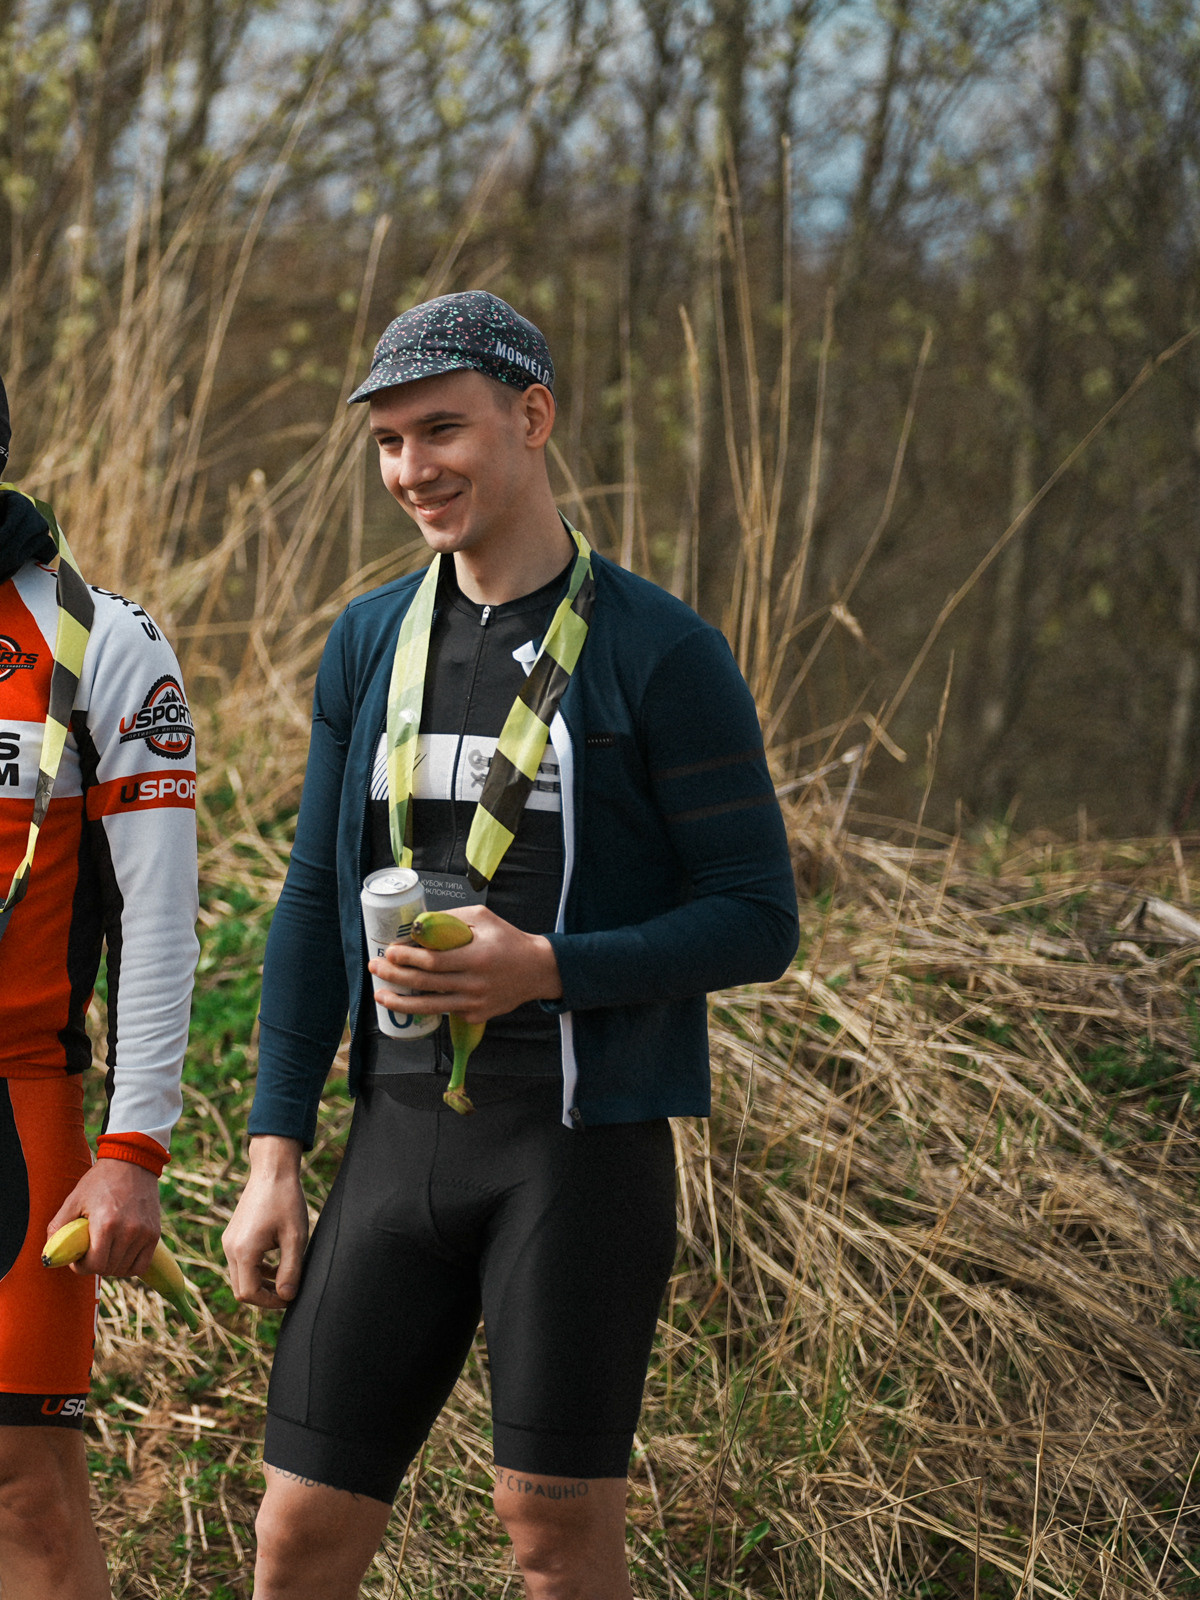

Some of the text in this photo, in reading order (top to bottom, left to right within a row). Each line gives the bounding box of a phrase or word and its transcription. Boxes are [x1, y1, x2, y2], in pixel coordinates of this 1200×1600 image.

[495, 341, 550, 385] MORVÉLO
[424, 888, 467, 900] ИКЛОКРОСС
[445, 881, 464, 890] ТИПА
[507, 1475, 589, 1500] СТРАШНО
